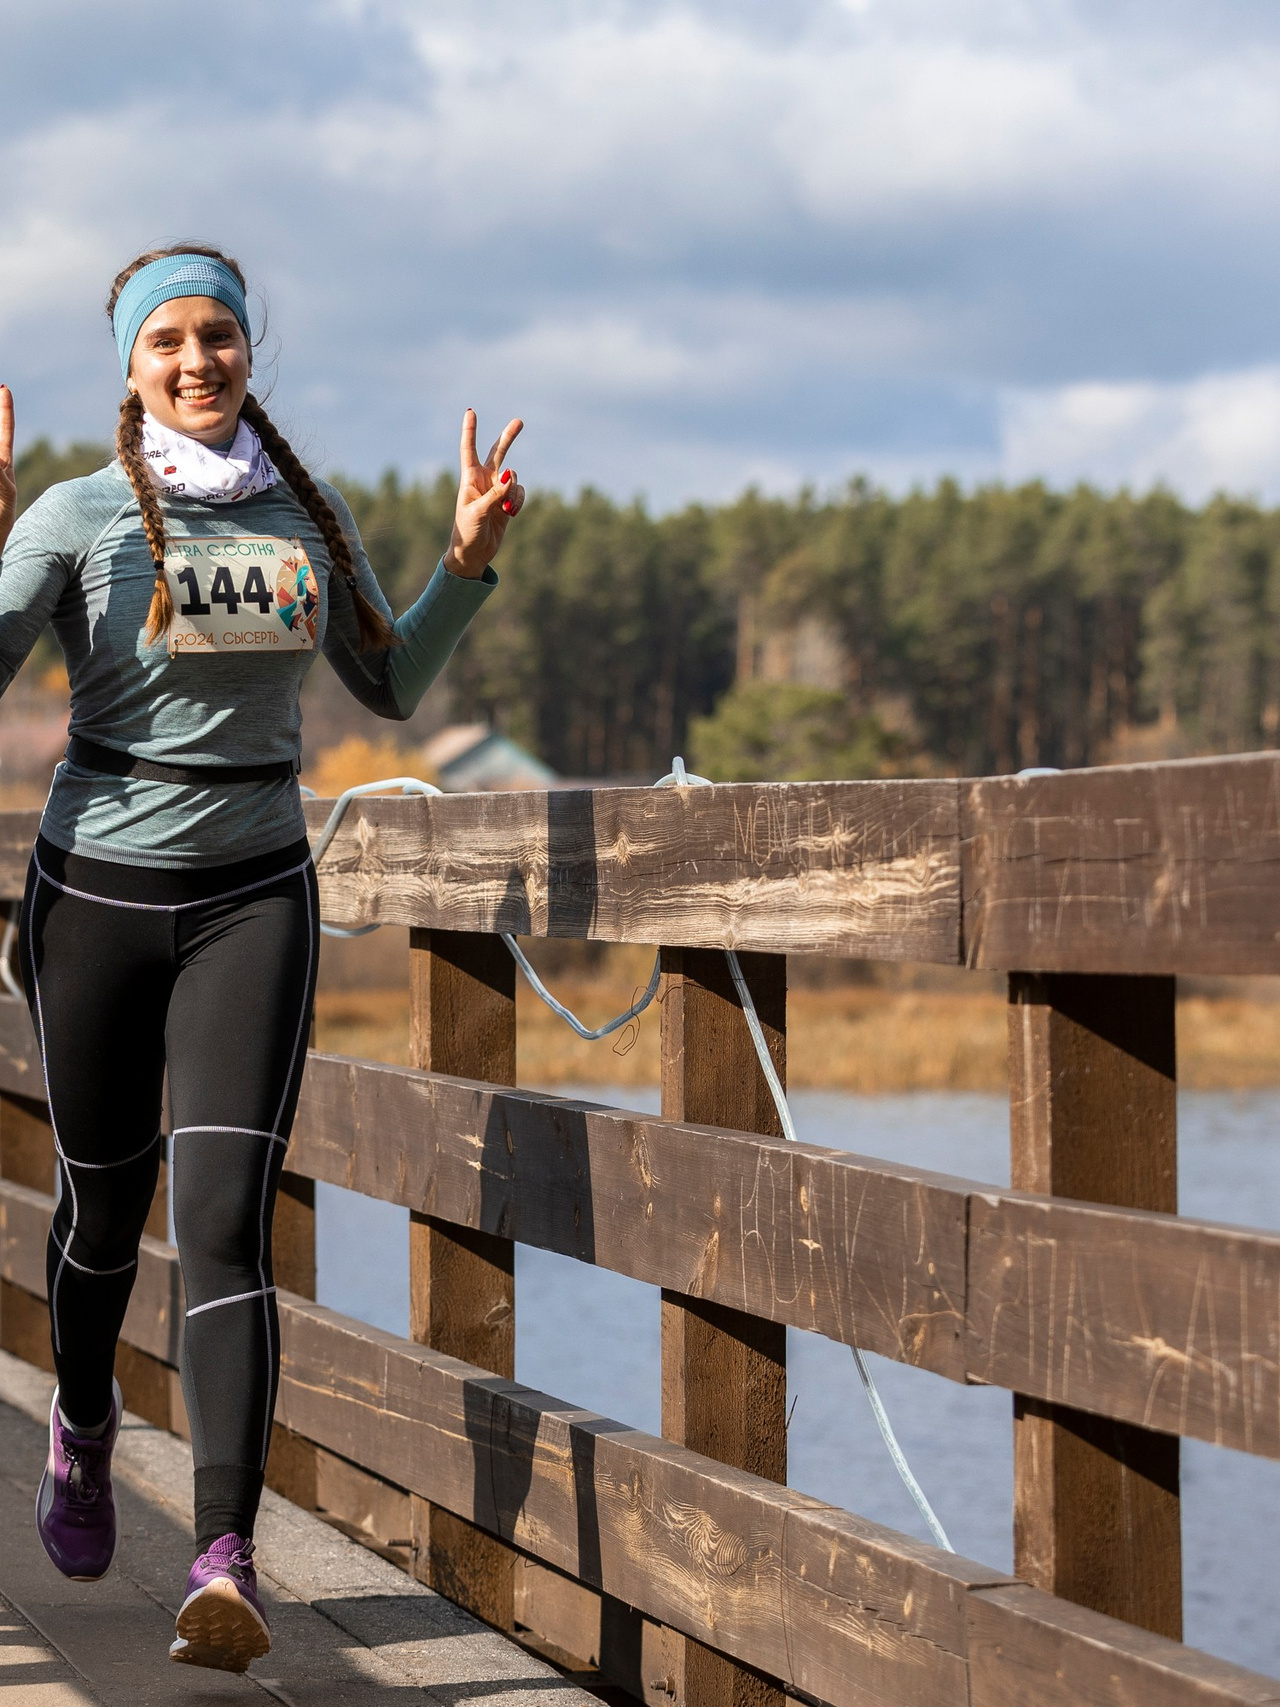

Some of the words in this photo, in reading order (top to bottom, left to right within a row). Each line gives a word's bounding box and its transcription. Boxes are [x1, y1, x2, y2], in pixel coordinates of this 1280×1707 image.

[206, 543, 276, 557] С.СОТНЯ
[176, 566, 274, 616] 144
[176, 632, 218, 646] 2024.
[222, 631, 280, 645] СЫСЕРТЬ
